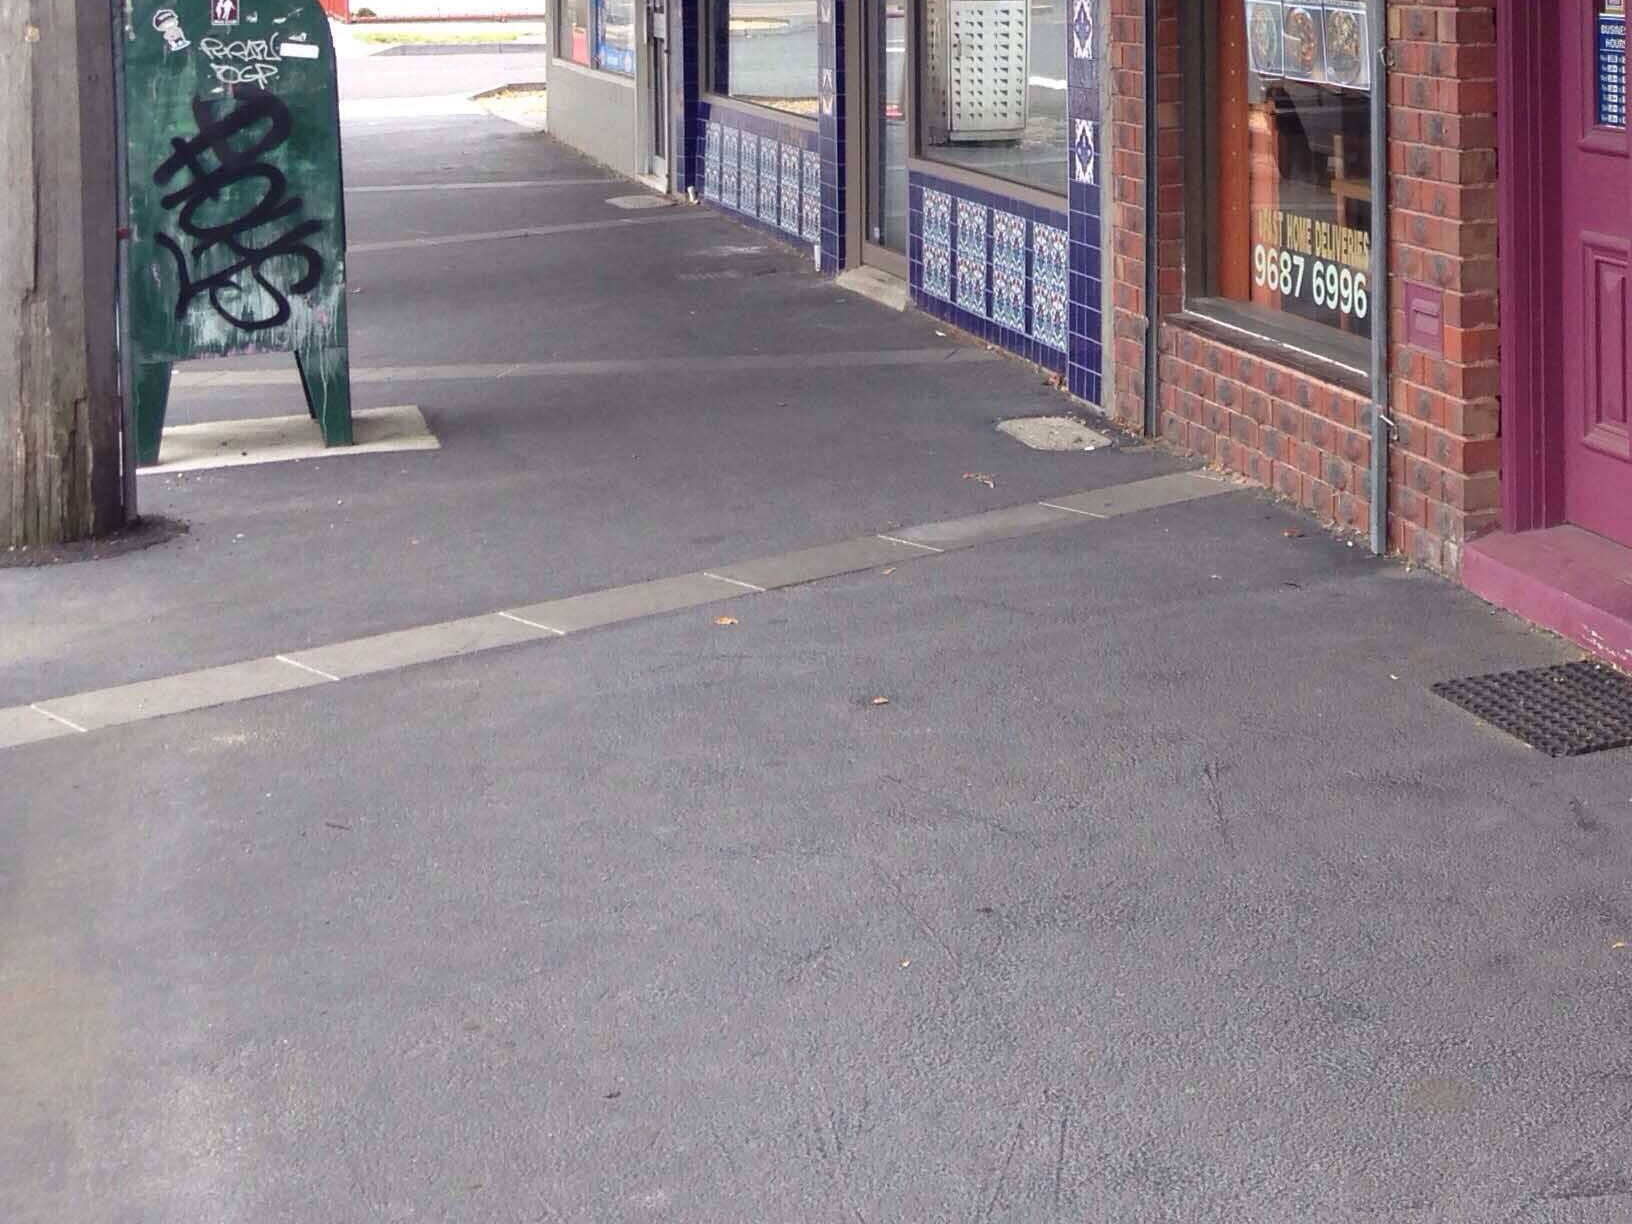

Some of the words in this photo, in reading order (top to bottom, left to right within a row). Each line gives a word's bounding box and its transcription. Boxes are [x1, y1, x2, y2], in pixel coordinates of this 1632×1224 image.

[1286, 213, 1313, 255] HOME
[1315, 220, 1371, 272] DELIVERIES
[1254, 244, 1305, 298] 9687
[1312, 261, 1368, 319] 6996
